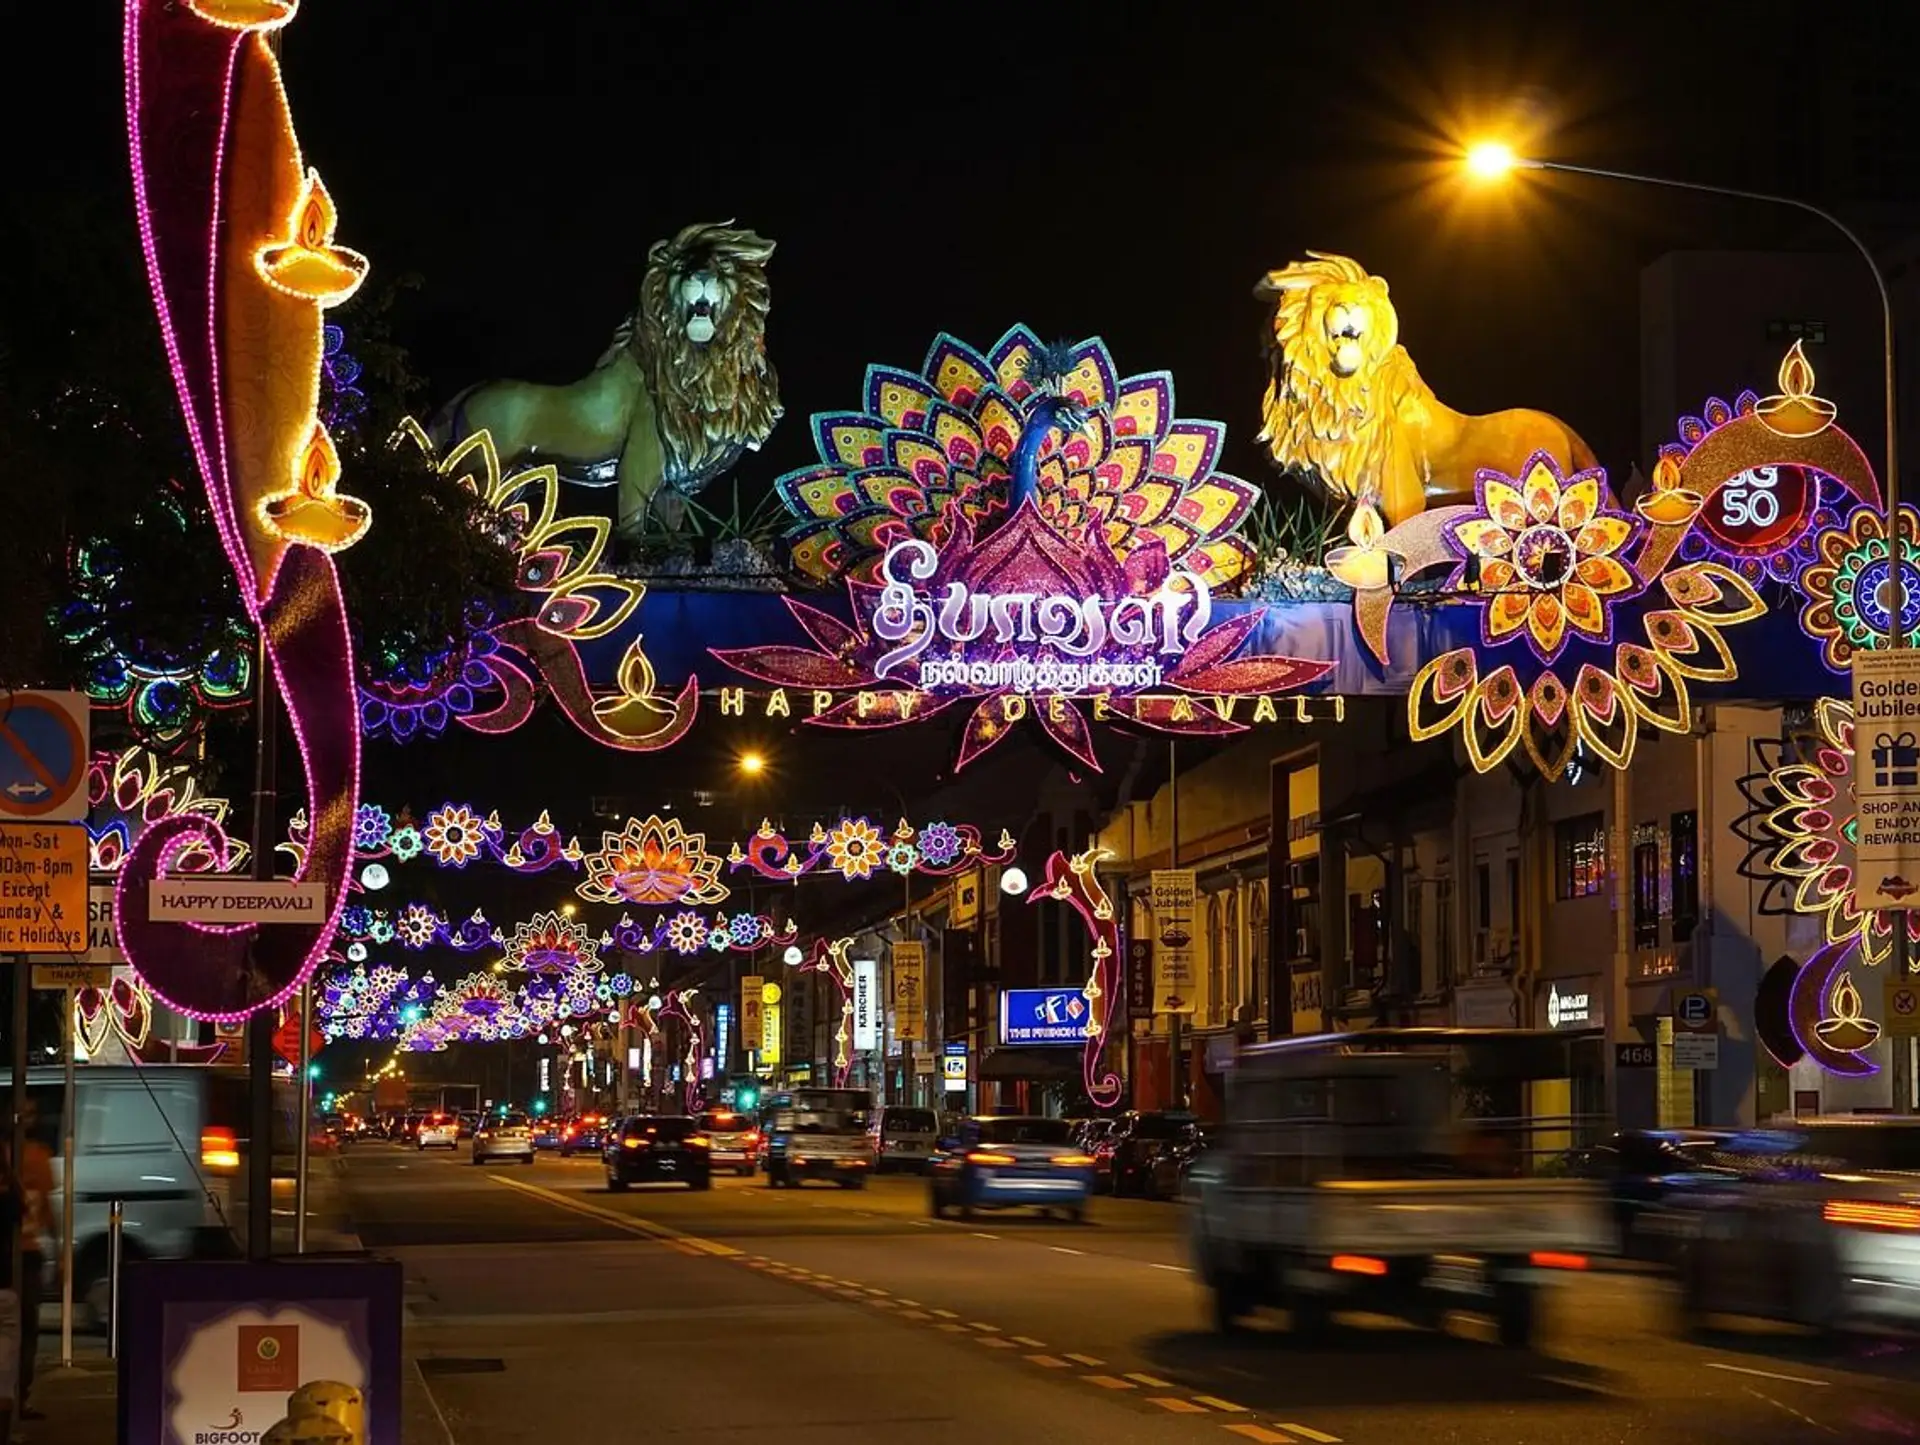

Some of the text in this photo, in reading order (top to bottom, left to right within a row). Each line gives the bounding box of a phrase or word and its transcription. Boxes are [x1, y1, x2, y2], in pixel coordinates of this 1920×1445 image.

[1722, 490, 1779, 526] 50
[873, 540, 1211, 679] தீபாவளி
[919, 653, 1164, 694] நல்வாழ்த்துக்கள்
[1860, 680, 1920, 697] Golde
[721, 688, 921, 718] HAPPY
[1862, 802, 1899, 815] SHOP
[1875, 816, 1920, 830] ENJOY
[0, 857, 73, 878] 0am-8pm
[2, 880, 51, 900] Except
[1155, 886, 1193, 897] Golden
[161, 894, 313, 910] HAPPY DEEPAVALI
[52, 903, 64, 920] &
[19, 926, 81, 945] Holidays
[1620, 1047, 1653, 1064] 468
[195, 1431, 260, 1445] BIGFOOT
